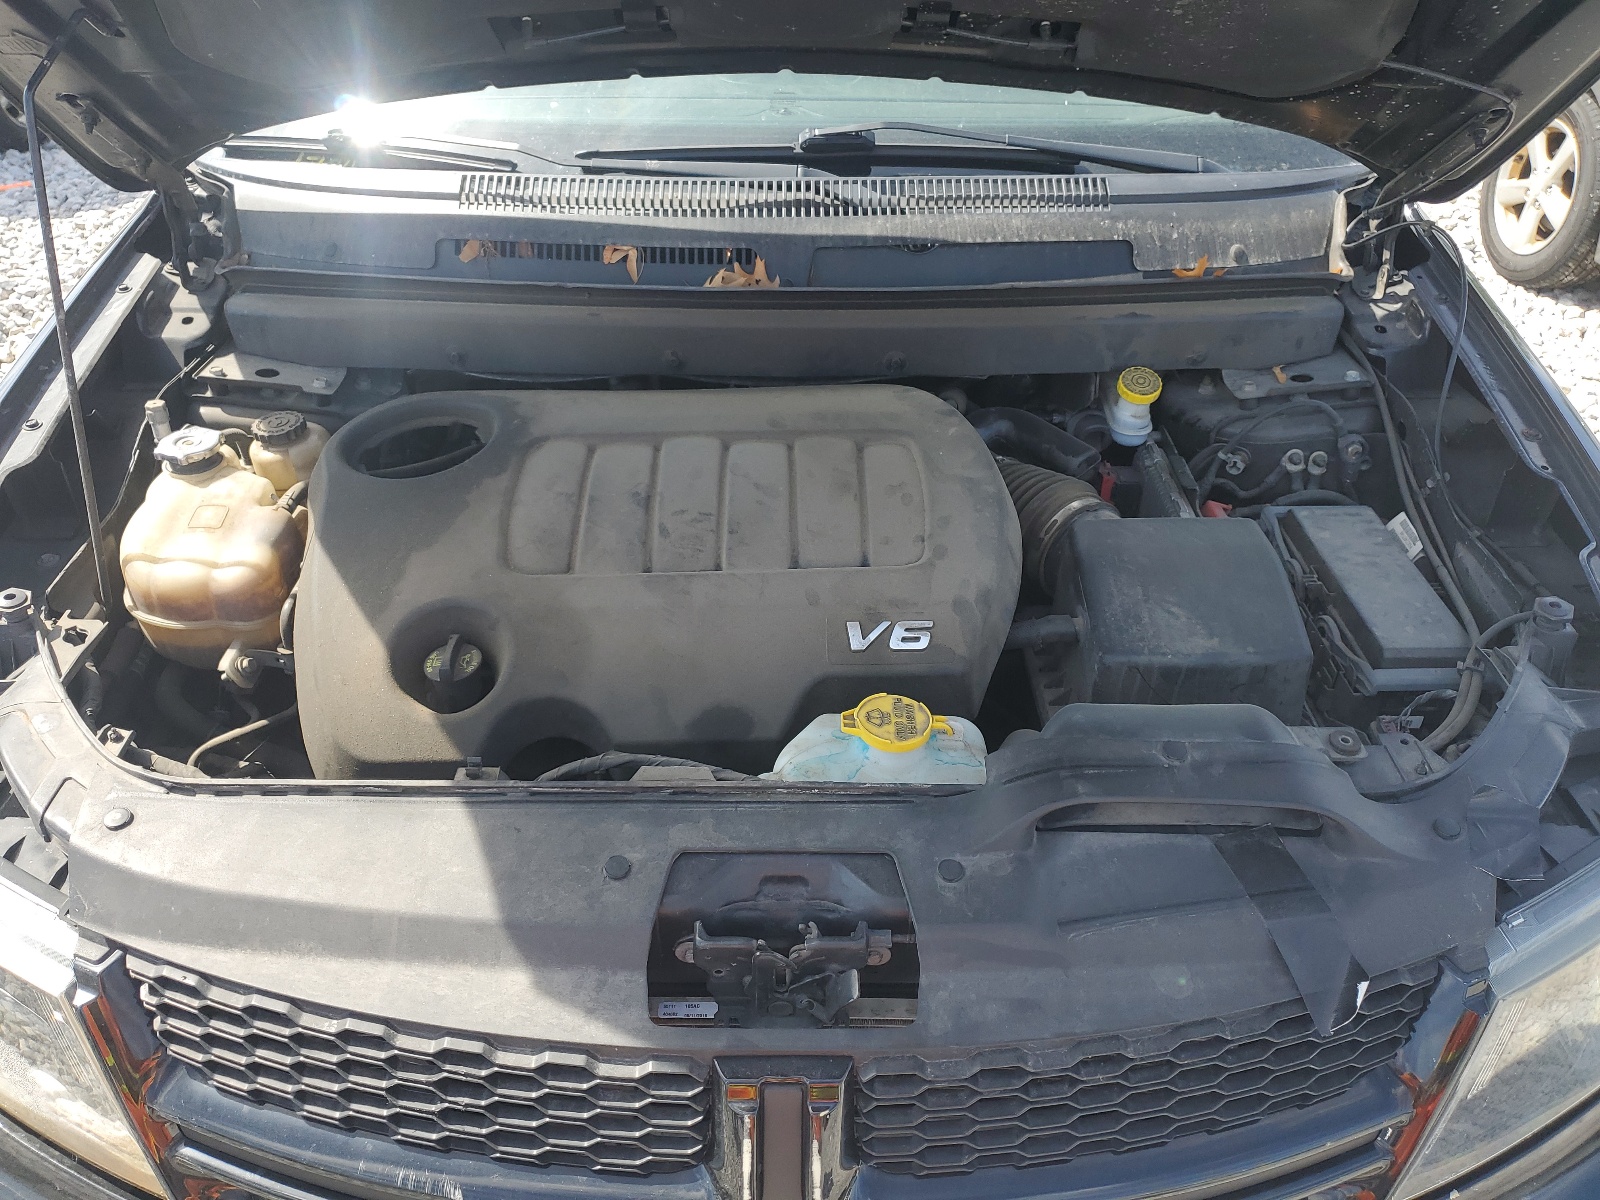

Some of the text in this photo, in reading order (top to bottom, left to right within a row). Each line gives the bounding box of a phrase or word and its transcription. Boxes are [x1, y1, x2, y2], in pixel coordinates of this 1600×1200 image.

[845, 620, 935, 652] V6
[892, 697, 907, 741] FLUID ONLY
